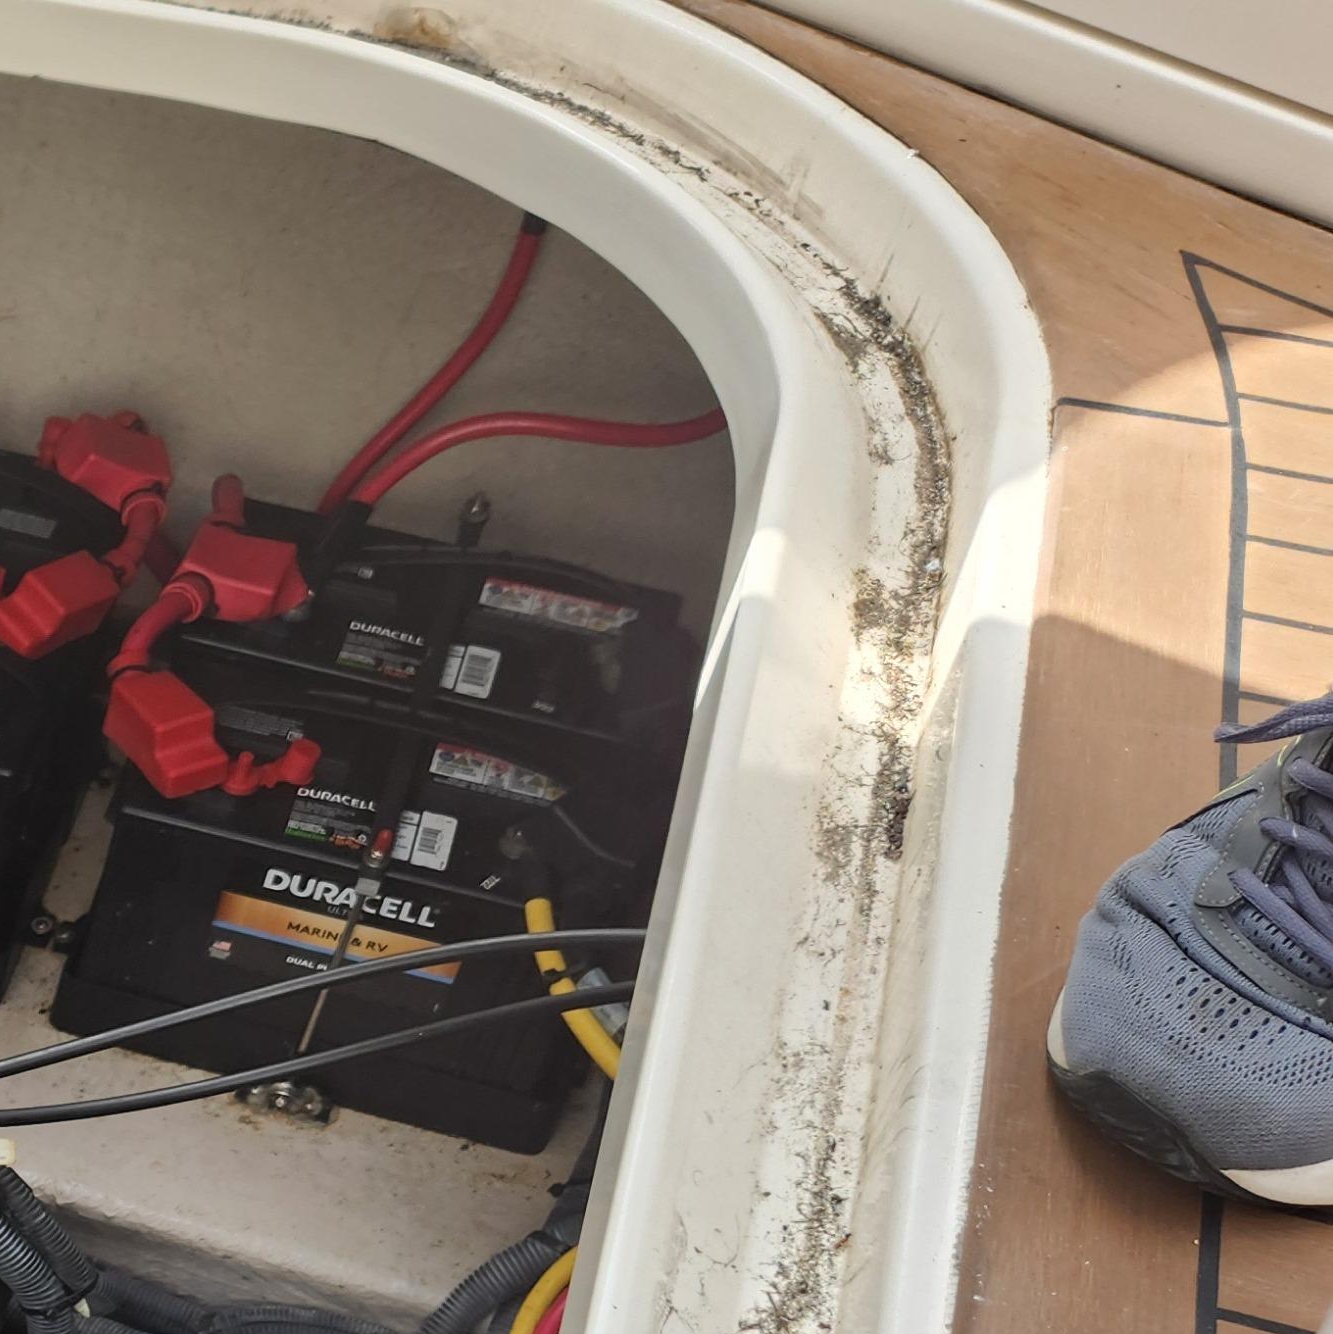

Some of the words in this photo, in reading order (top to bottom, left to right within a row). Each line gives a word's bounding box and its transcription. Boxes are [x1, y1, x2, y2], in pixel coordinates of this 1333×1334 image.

[349, 620, 426, 647] DURACELL
[297, 787, 377, 812] DURACELL
[262, 868, 436, 929] DURACELL
[287, 920, 341, 943] MARIN
[350, 937, 363, 947] &
[365, 937, 389, 953] RV
[286, 956, 315, 969] DUAL
